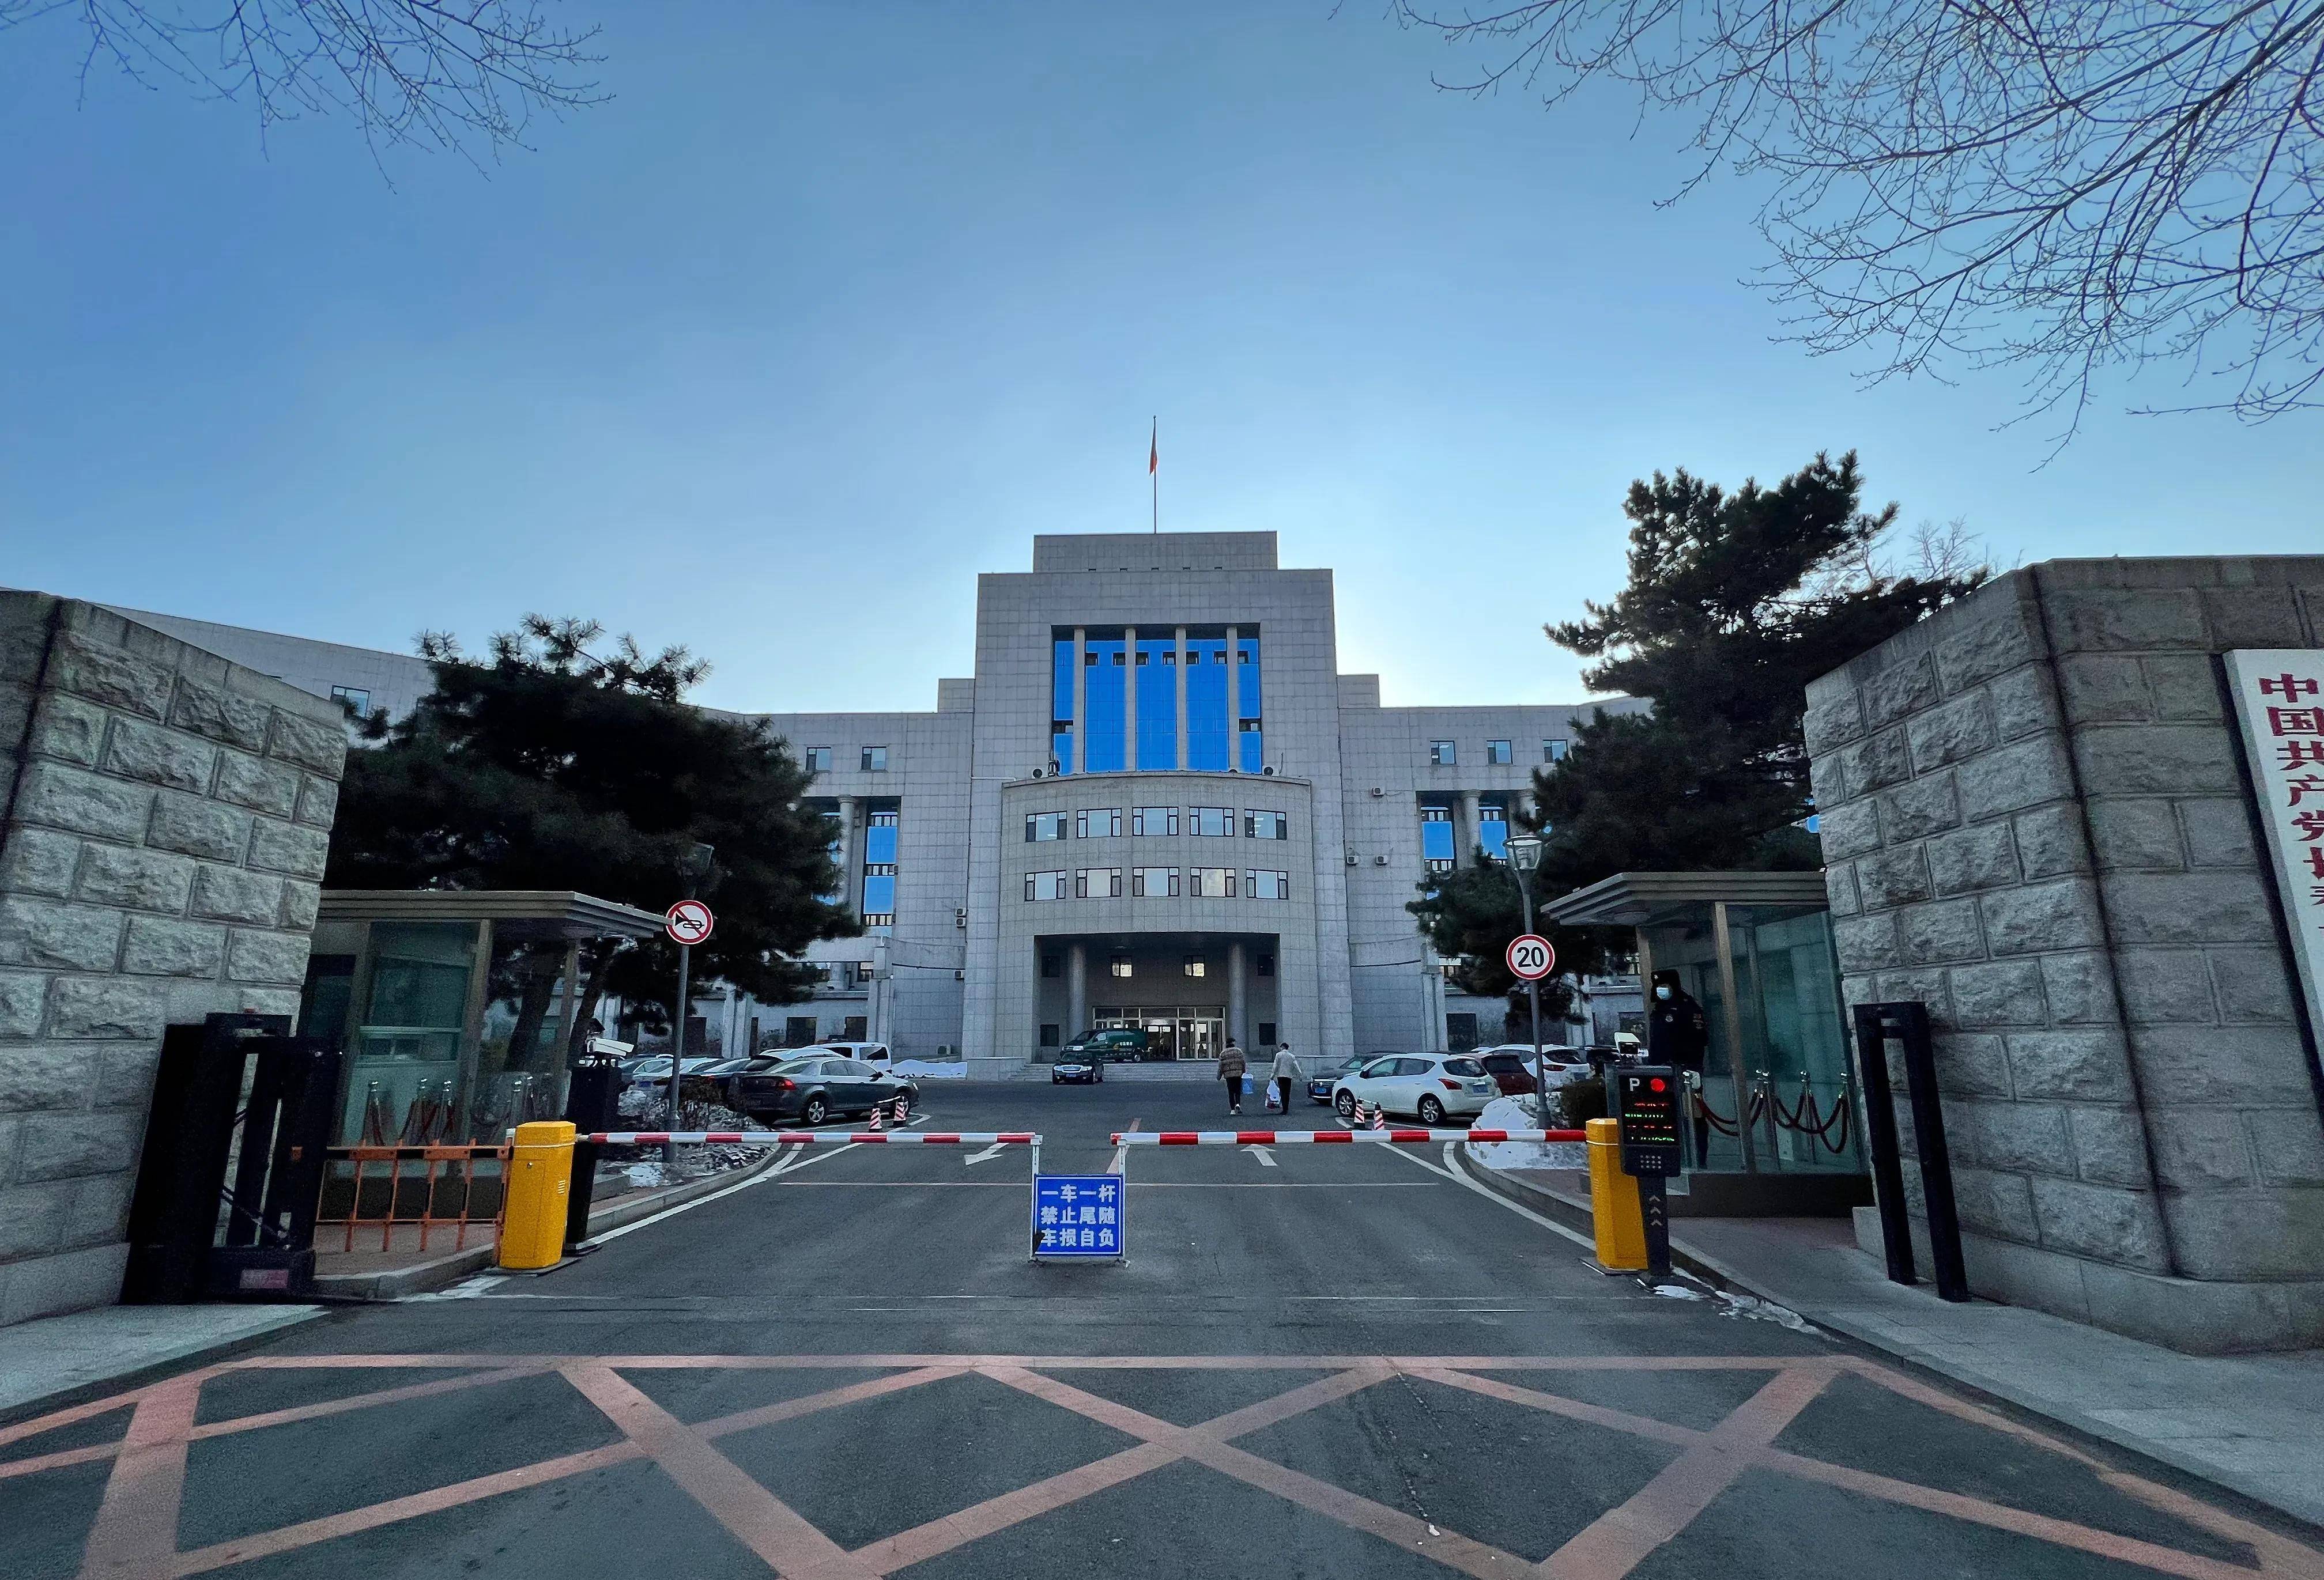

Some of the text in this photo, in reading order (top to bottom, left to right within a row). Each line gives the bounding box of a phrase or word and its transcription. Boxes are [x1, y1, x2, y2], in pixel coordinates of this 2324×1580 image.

[1517, 946, 1544, 967] 20
[1629, 1078, 1640, 1091] P
[1041, 1184, 1115, 1203] 一车一杆
[1041, 1205, 1115, 1224] 禁止尾随
[1040, 1228, 1114, 1246] 车损自负
